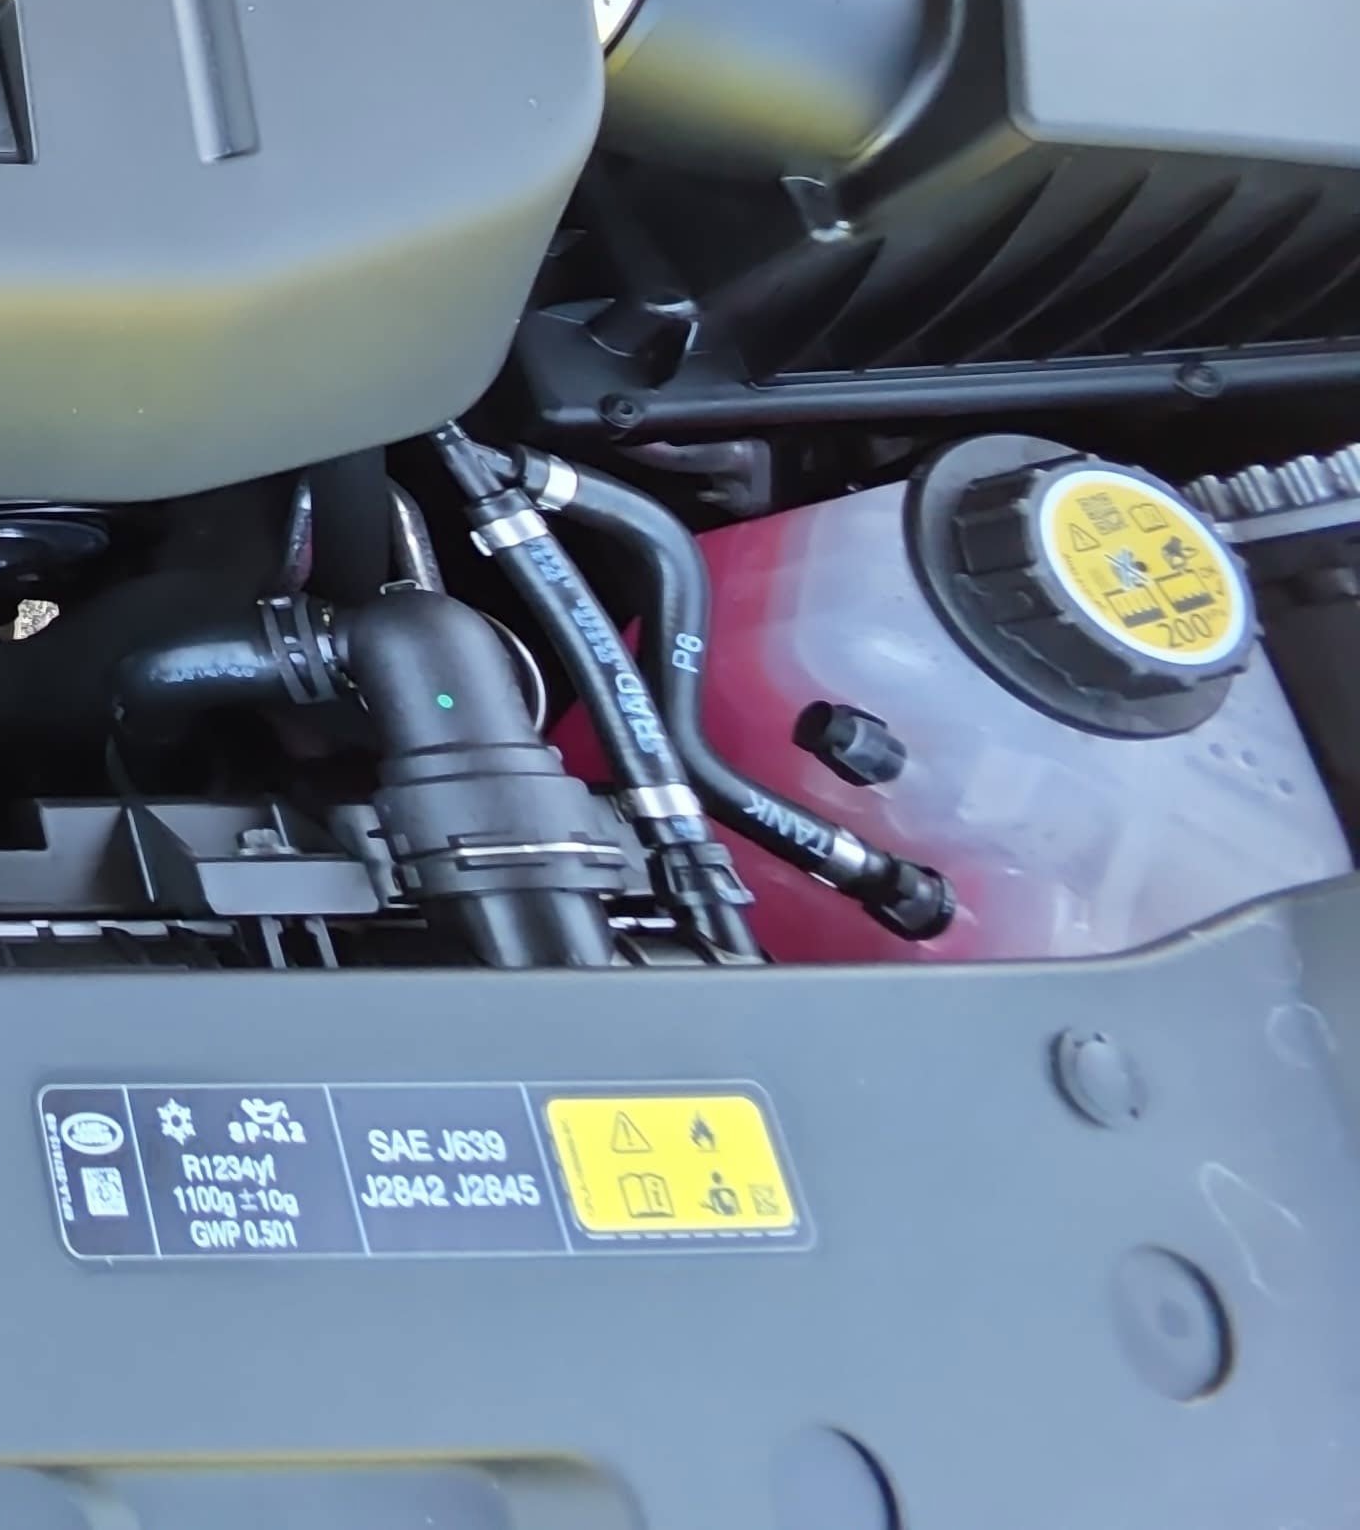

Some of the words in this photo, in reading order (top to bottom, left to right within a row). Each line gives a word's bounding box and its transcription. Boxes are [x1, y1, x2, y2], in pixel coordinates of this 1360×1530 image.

[1157, 613, 1213, 649] 200
[671, 632, 704, 674] P6
[742, 790, 835, 859] TANK
[368, 1129, 434, 1163] SAE
[437, 1129, 507, 1163] J639
[172, 1185, 238, 1219] 1100g
[361, 1173, 450, 1208] J2842
[452, 1173, 542, 1208] J2845
[189, 1219, 241, 1248] GWP
[242, 1219, 298, 1248] 0.501
